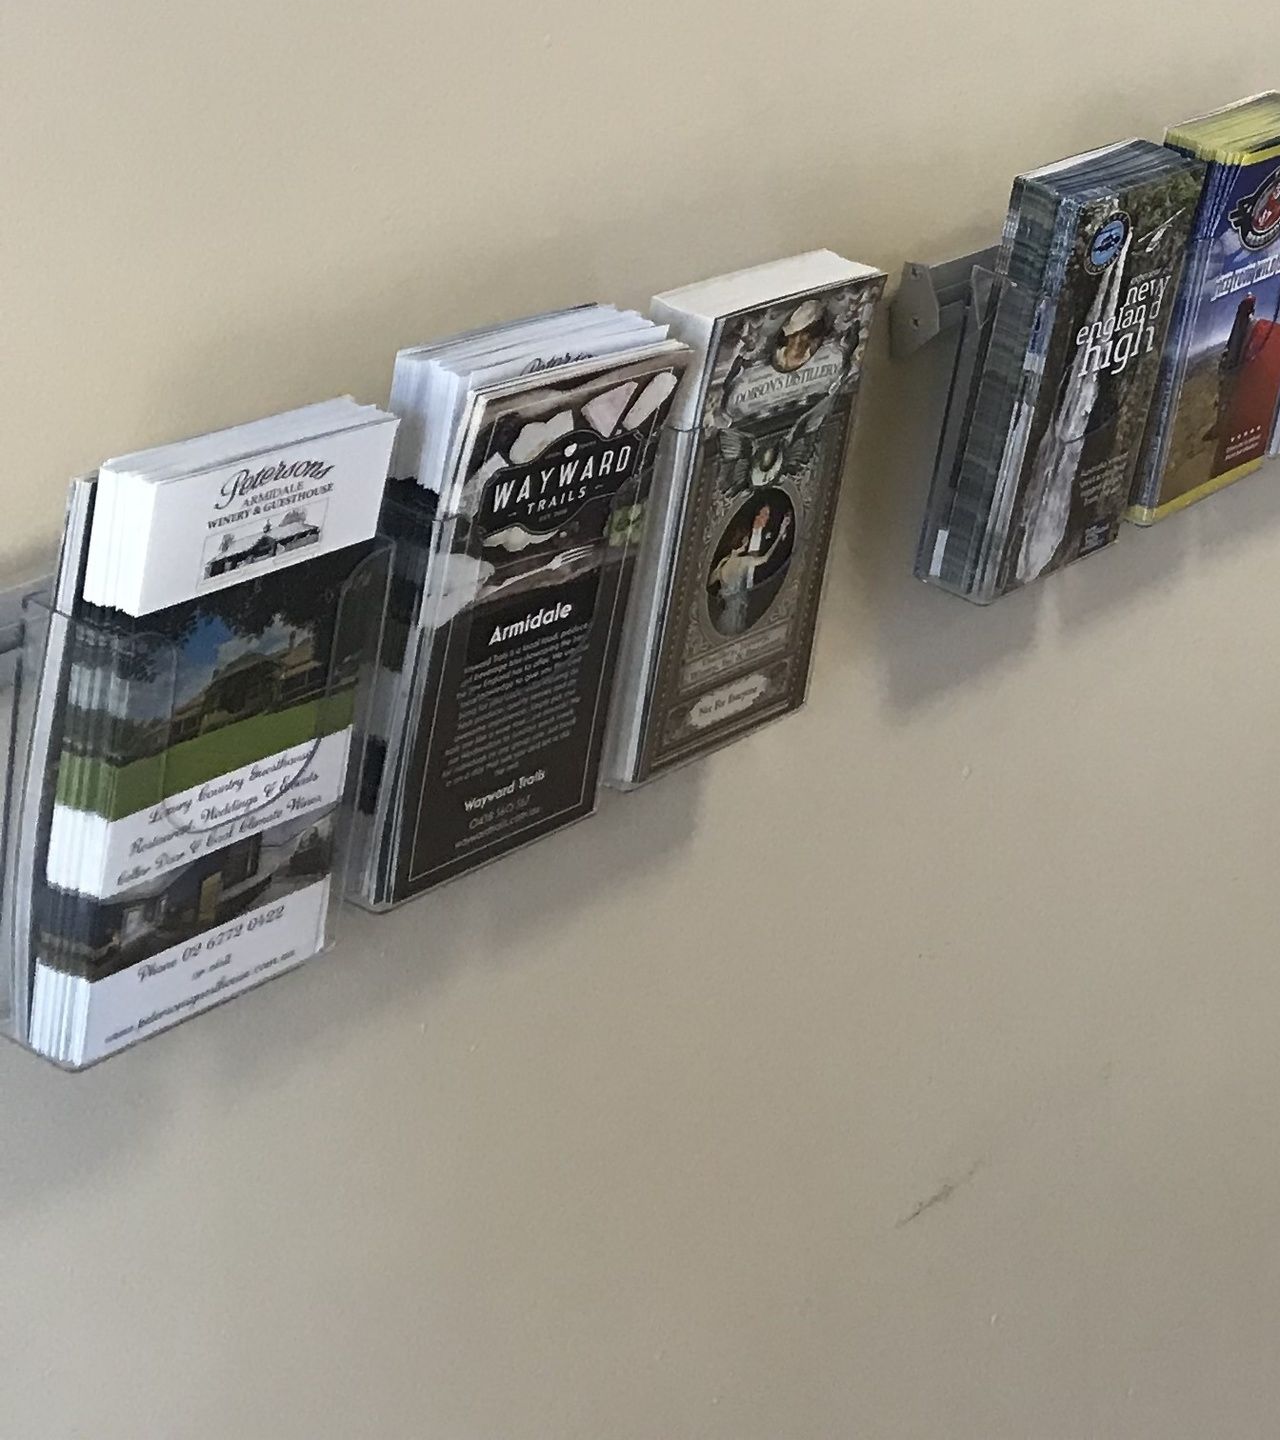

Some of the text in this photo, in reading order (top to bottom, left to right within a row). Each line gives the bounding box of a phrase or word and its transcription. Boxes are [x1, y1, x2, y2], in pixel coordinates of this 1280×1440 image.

[1125, 274, 1172, 307] new
[1076, 300, 1161, 346] england
[1078, 317, 1155, 377] high
[785, 363, 838, 389] DISTILLERY
[214, 460, 335, 510] Petersons
[242, 481, 304, 507] ARMIDALE
[493, 445, 632, 513] WAYWARD
[527, 485, 587, 515] TRAILS
[207, 482, 334, 529] WINERY & GUESTHOUSE
[488, 602, 573, 646] Armidale
[198, 778, 244, 801] Country
[201, 796, 258, 822] Weddings
[465, 769, 546, 811] Wayward Trails
[155, 795, 322, 867] Door Cool Climate Wines
[137, 905, 285, 982] Phone 02 6772 0422
